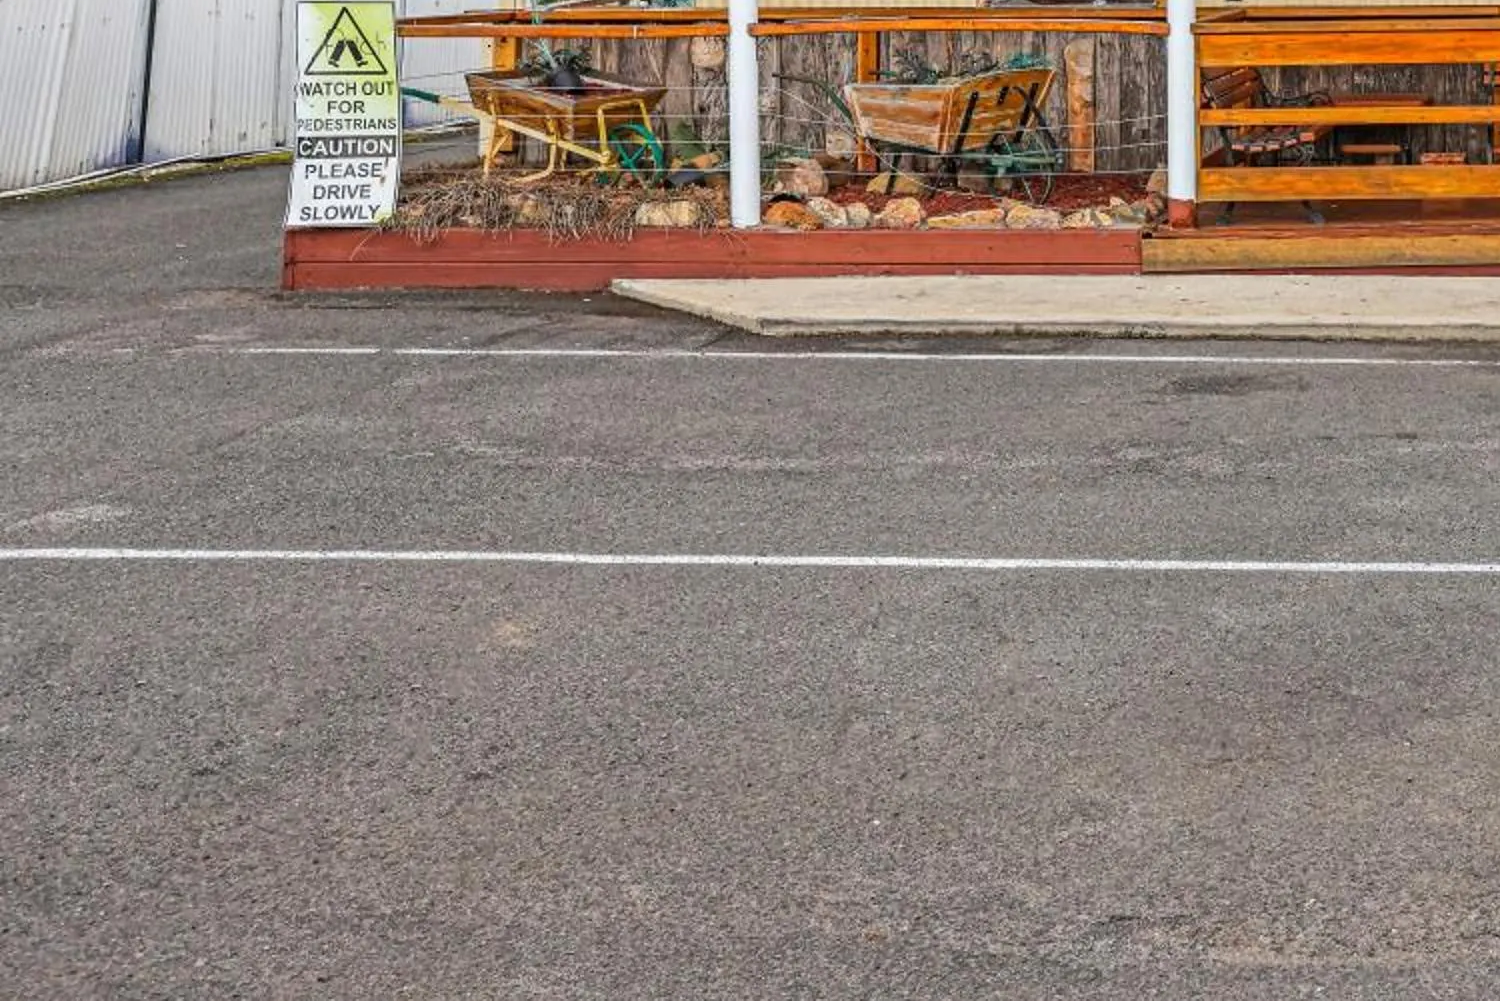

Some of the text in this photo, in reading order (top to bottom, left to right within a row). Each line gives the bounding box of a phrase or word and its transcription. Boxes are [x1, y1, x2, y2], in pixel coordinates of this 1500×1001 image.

[299, 81, 394, 96] WATCH OUT
[327, 101, 365, 114] FOR
[298, 118, 396, 131] PEDESTRIANS
[299, 139, 393, 156] CAUTION
[305, 163, 382, 179] PLEASE
[313, 184, 371, 199] DRIVE
[299, 204, 380, 221] SLOWLY
